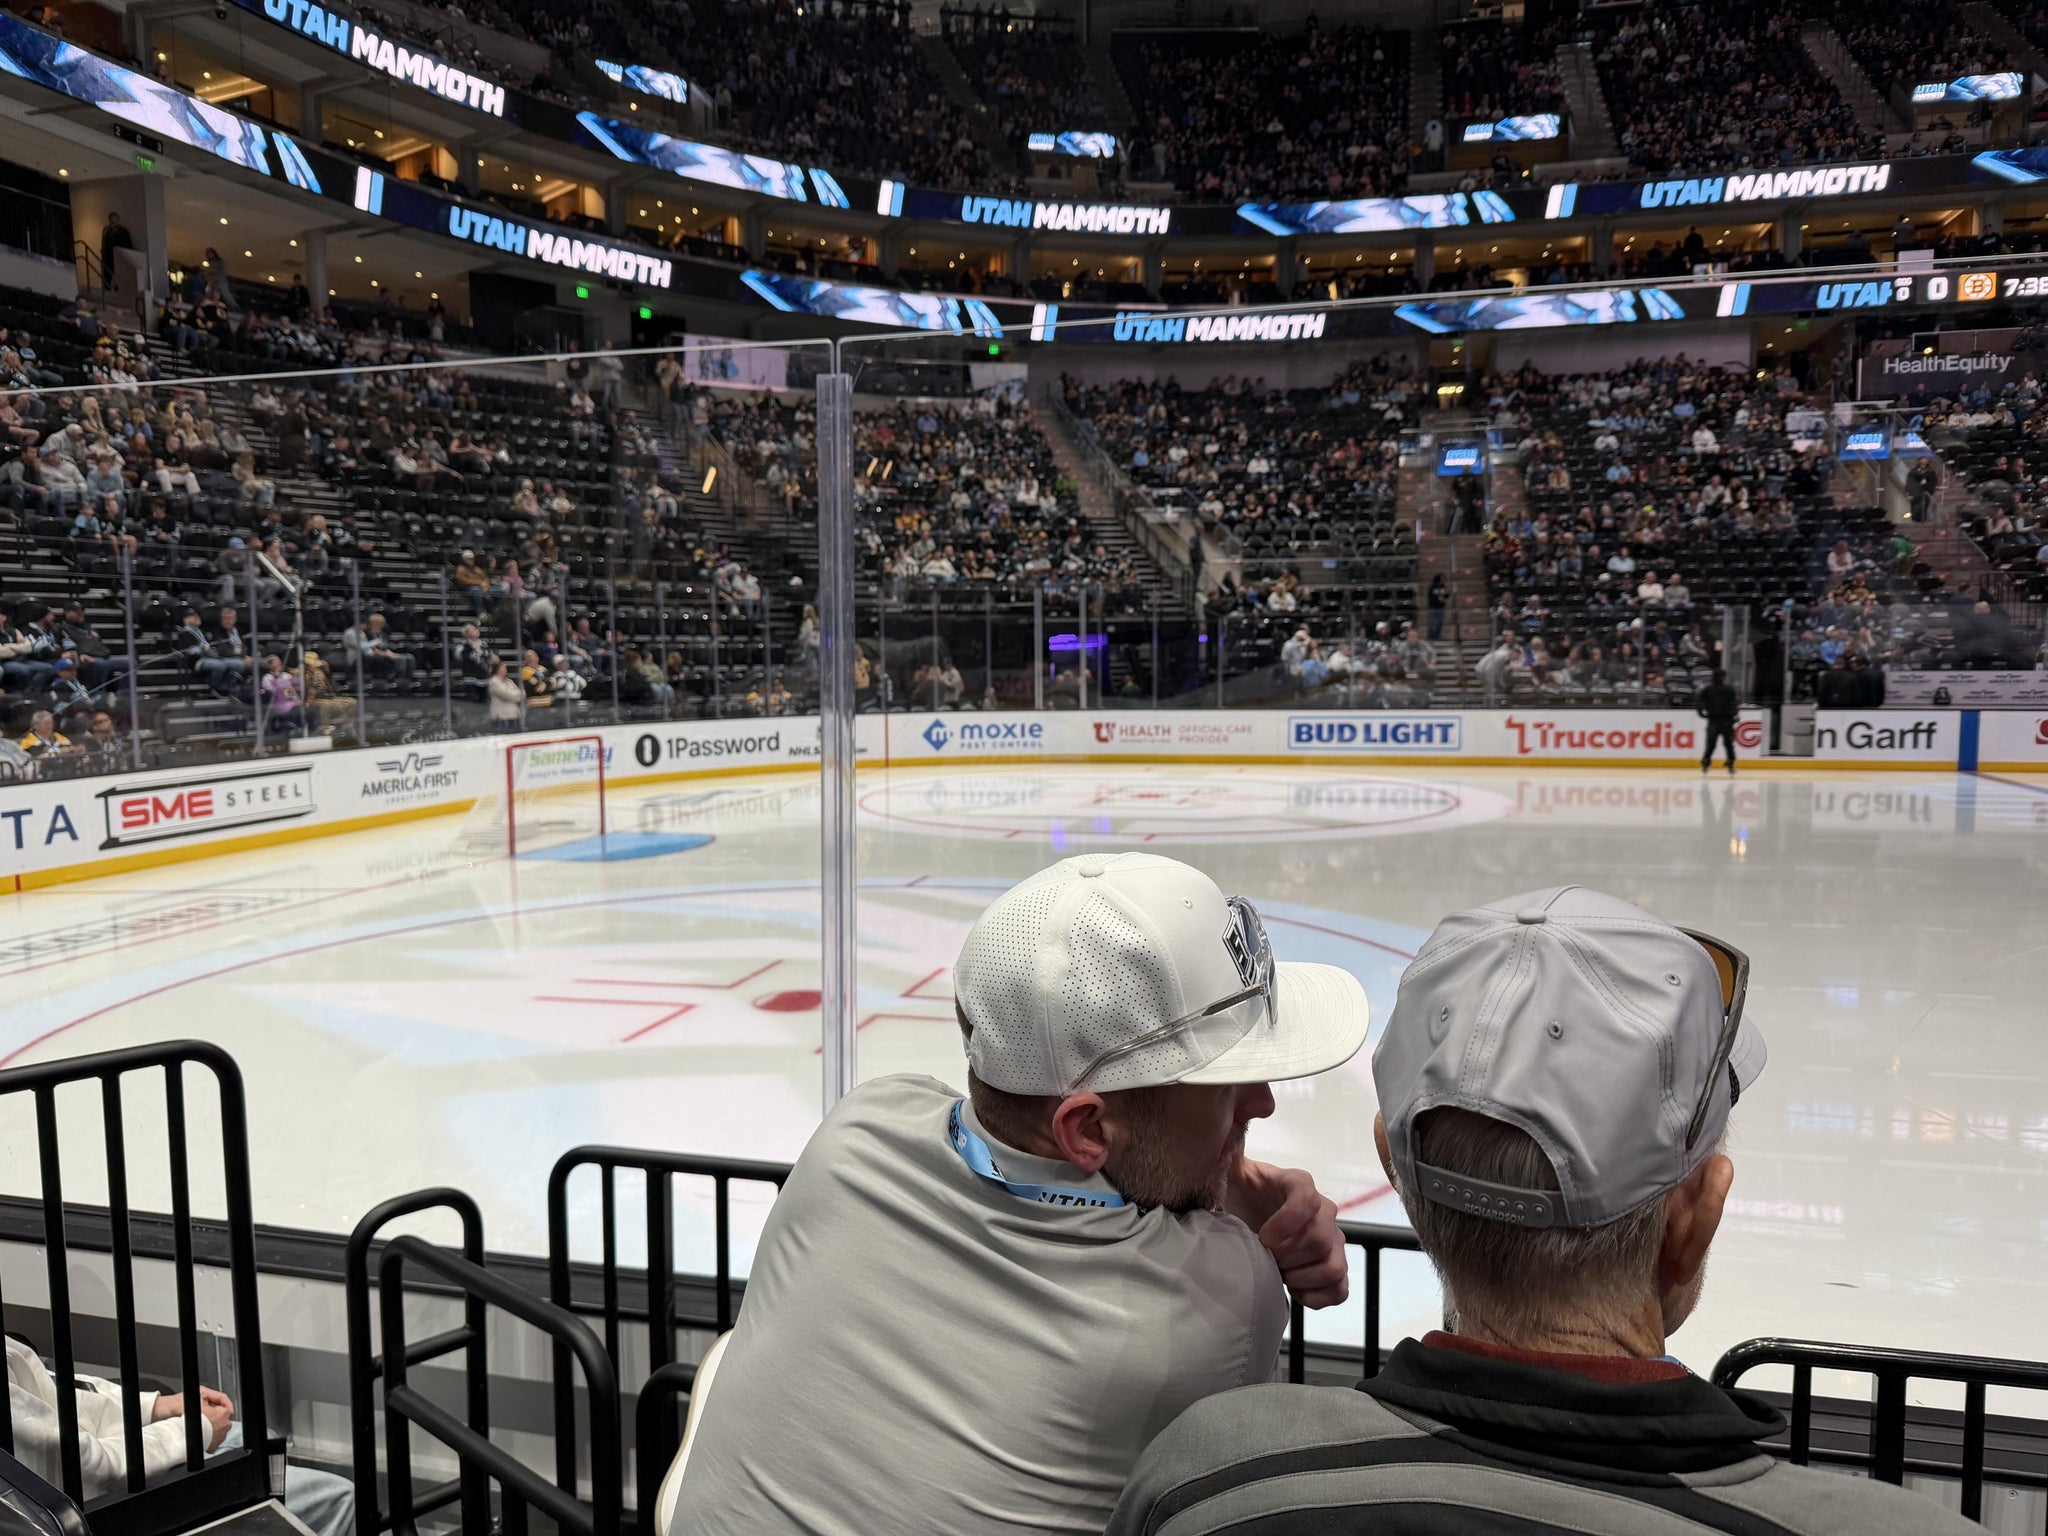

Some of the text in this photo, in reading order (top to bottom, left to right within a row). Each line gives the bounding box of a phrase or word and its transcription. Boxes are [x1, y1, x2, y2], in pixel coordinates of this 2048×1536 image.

[264, 0, 505, 117] UTAH MAMMOTH
[1639, 164, 1890, 209] UTAH MAMMOTH
[961, 196, 1171, 234] UTAH MAMMOTH
[449, 206, 672, 288] UTAH MAMMOTH
[1928, 277, 1948, 300] 0
[1113, 312, 1326, 342] UTAH MAMMOTH
[1884, 351, 2011, 374] HealthEquity
[960, 723, 1043, 739] moxie
[1119, 725, 1172, 737] HEALTH
[1295, 723, 1455, 743] BUD LIGHT
[1533, 722, 1695, 749] Trucordia
[1846, 721, 1938, 749] Garff
[666, 732, 781, 759] 1Password
[361, 770, 460, 797] AMERICA FIRST
[121, 783, 302, 829] SME STEEL
[1464, 1203, 1525, 1224] RICHARDSON
